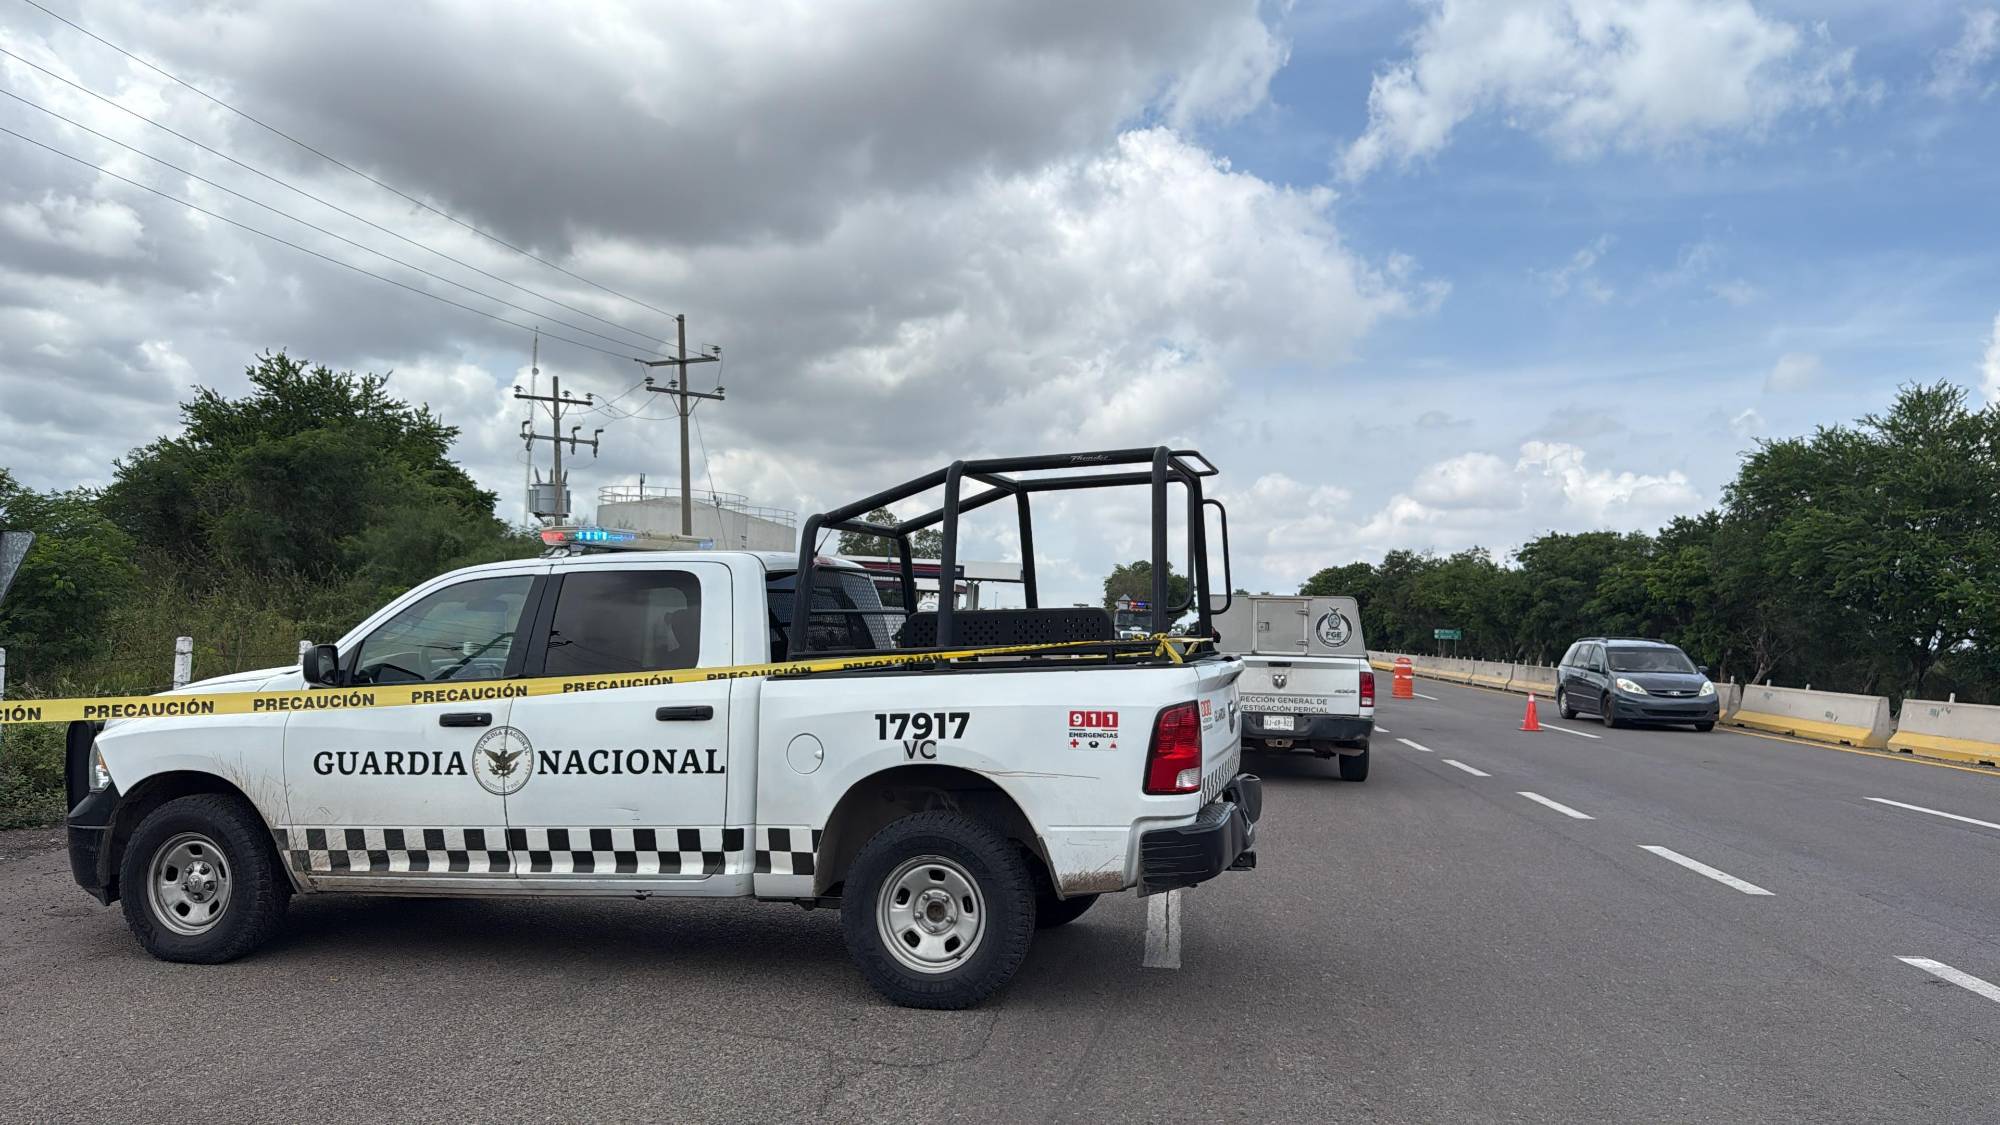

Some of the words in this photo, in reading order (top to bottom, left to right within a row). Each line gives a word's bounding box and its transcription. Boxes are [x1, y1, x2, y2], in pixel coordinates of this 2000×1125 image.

[1325, 631, 1342, 639] FGE
[84, 699, 215, 719] PRECAUCIÓN
[253, 691, 375, 712] PRECAUCIÓN
[411, 683, 528, 703] PRECAUCIÓN
[562, 674, 674, 693] PRECAUCIÓN
[1277, 697, 1315, 705] GENERAL
[1316, 698, 1328, 706] DE
[1293, 706, 1328, 714] PERICIAL
[874, 712, 971, 741] 17917
[1071, 712, 1115, 727] 911
[903, 740, 937, 760] VC
[312, 751, 468, 776] GUARDIA
[537, 749, 726, 774] NACIONAL
